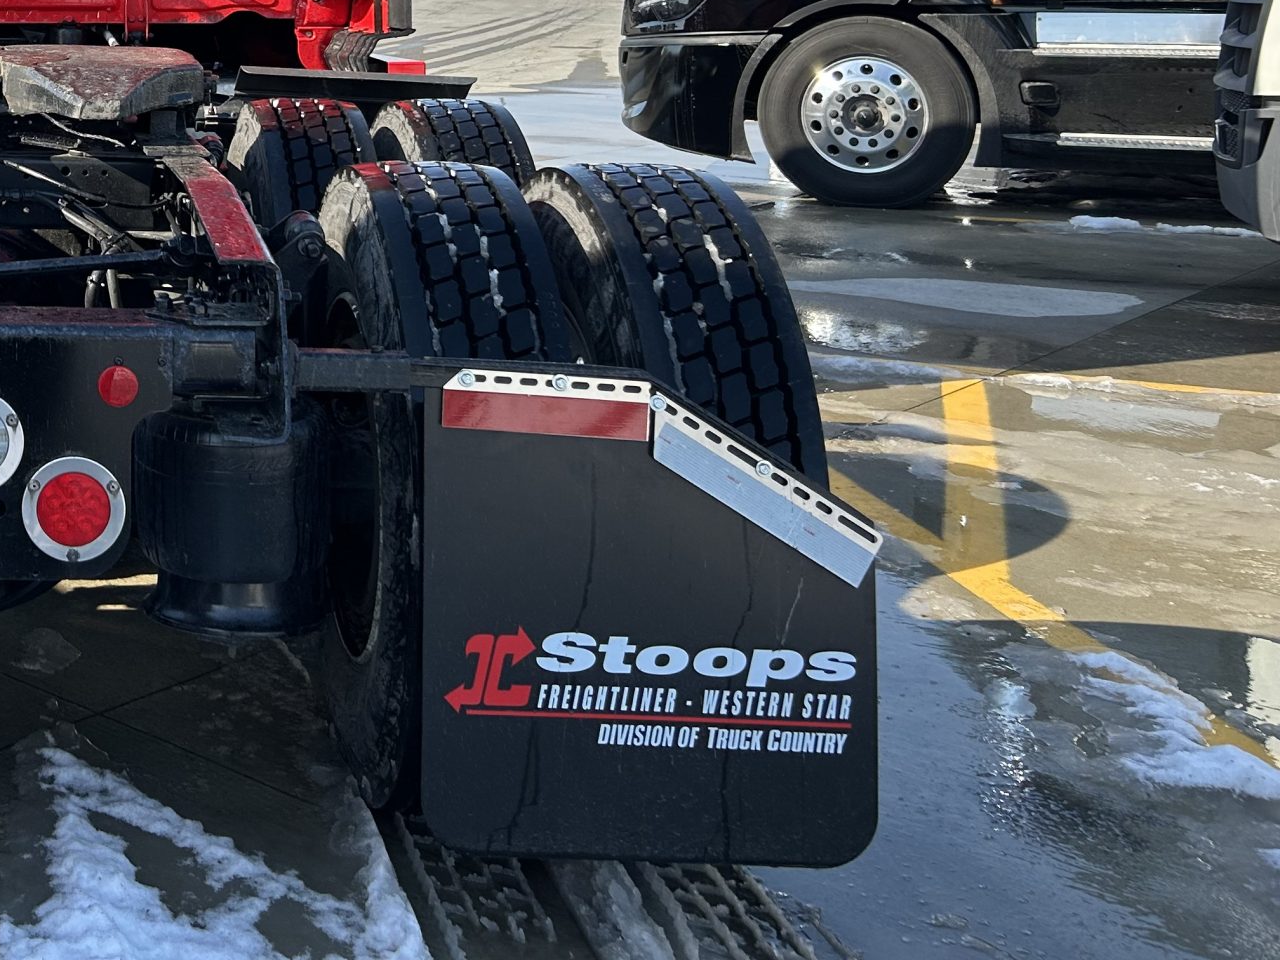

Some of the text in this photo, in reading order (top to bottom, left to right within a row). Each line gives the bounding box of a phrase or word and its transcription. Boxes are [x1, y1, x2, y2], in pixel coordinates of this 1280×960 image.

[535, 631, 857, 688] Stoops
[537, 683, 677, 714] FREIGHTLINER
[702, 689, 794, 718] WESTERN
[801, 692, 852, 721] STAR
[597, 723, 848, 755] DIVISION OF TRUCK COUNTRY
